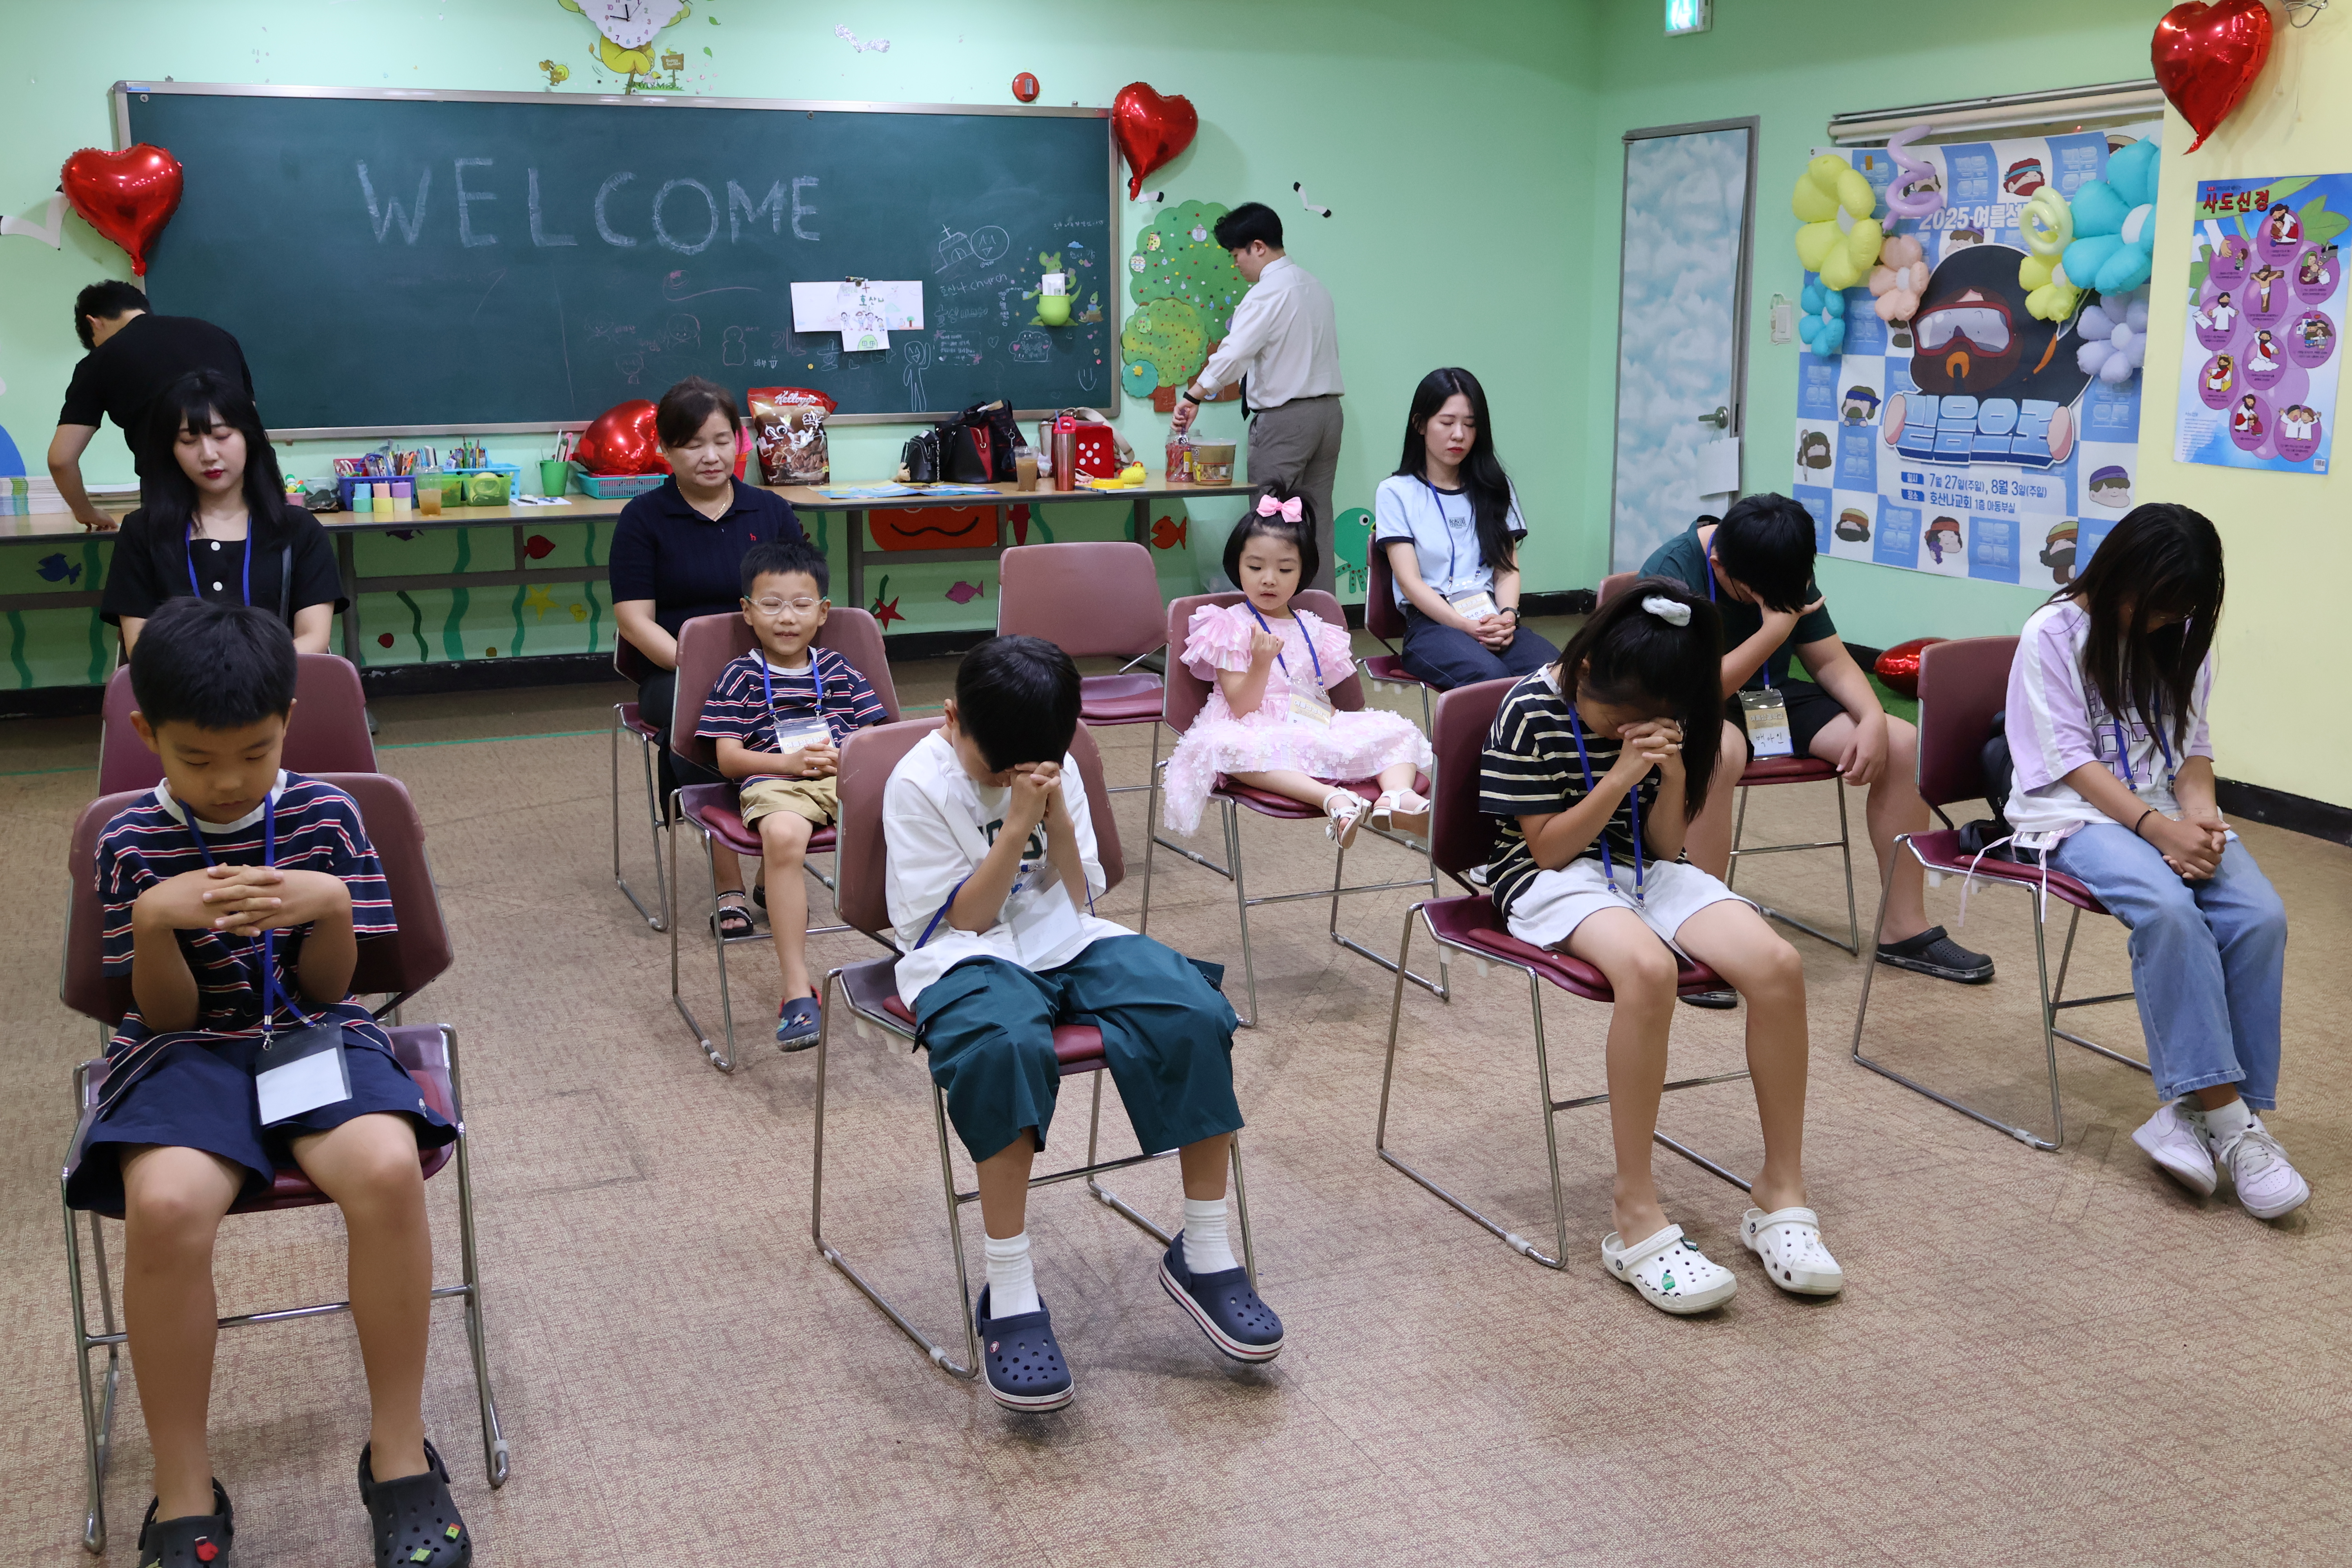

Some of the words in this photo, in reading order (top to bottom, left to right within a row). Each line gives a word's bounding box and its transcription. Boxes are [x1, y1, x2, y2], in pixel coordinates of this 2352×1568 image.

[356, 156, 821, 255] WELCOME
[2203, 190, 2270, 214] 사도신경
[1919, 207, 1969, 230] 2025
[1974, 203, 2040, 229] 여름성
[940, 282, 967, 296] 호산나
[970, 273, 1007, 290] church
[1896, 393, 2060, 463] 믿음으로
[1929, 473, 1942, 487] 7월
[1991, 479, 2008, 495] 8월
[2012, 481, 2047, 498] 3일(주일)
[1930, 491, 1972, 508] 호산나교회
[1975, 499, 1985, 510] 1층
[1987, 500, 2015, 513] 아동부실
[1749, 712, 1784, 721] 여름성경학교
[1756, 732, 1784, 747] 백아인
